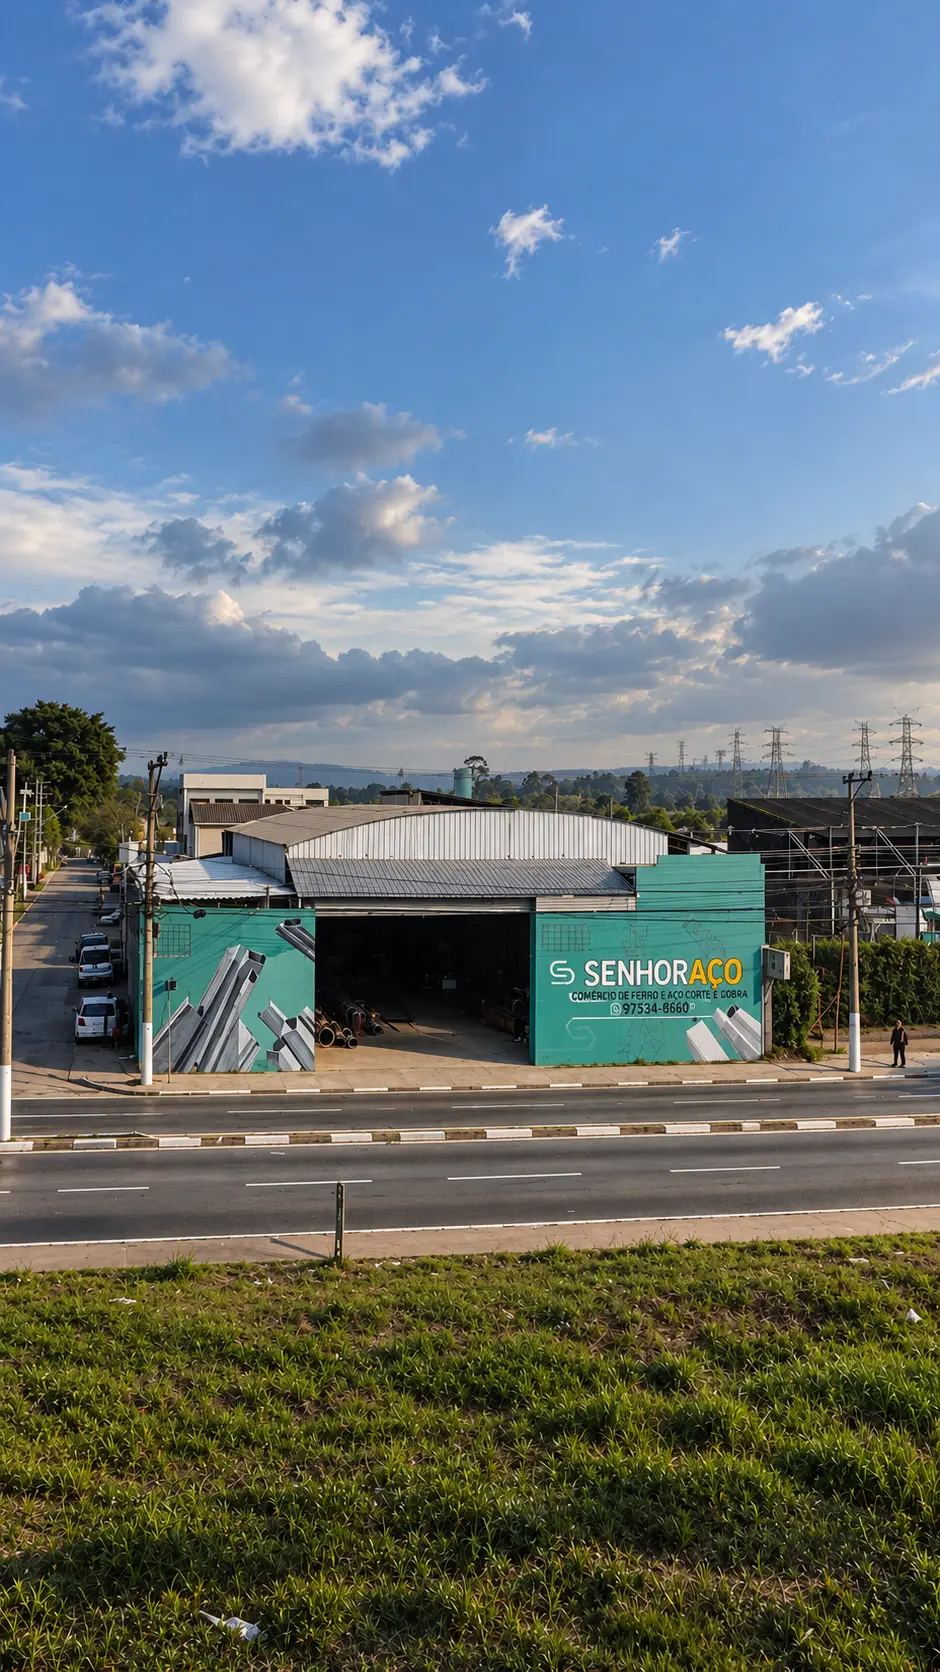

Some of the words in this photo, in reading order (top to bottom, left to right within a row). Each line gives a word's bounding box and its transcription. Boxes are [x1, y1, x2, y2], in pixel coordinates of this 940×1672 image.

[584, 958, 743, 990] SENHORAÇO
[618, 990, 629, 1000] DE
[631, 990, 658, 1000] FERRO
[660, 990, 667, 999] E
[667, 990, 684, 1000] AÇO
[685, 990, 710, 999] CORTE
